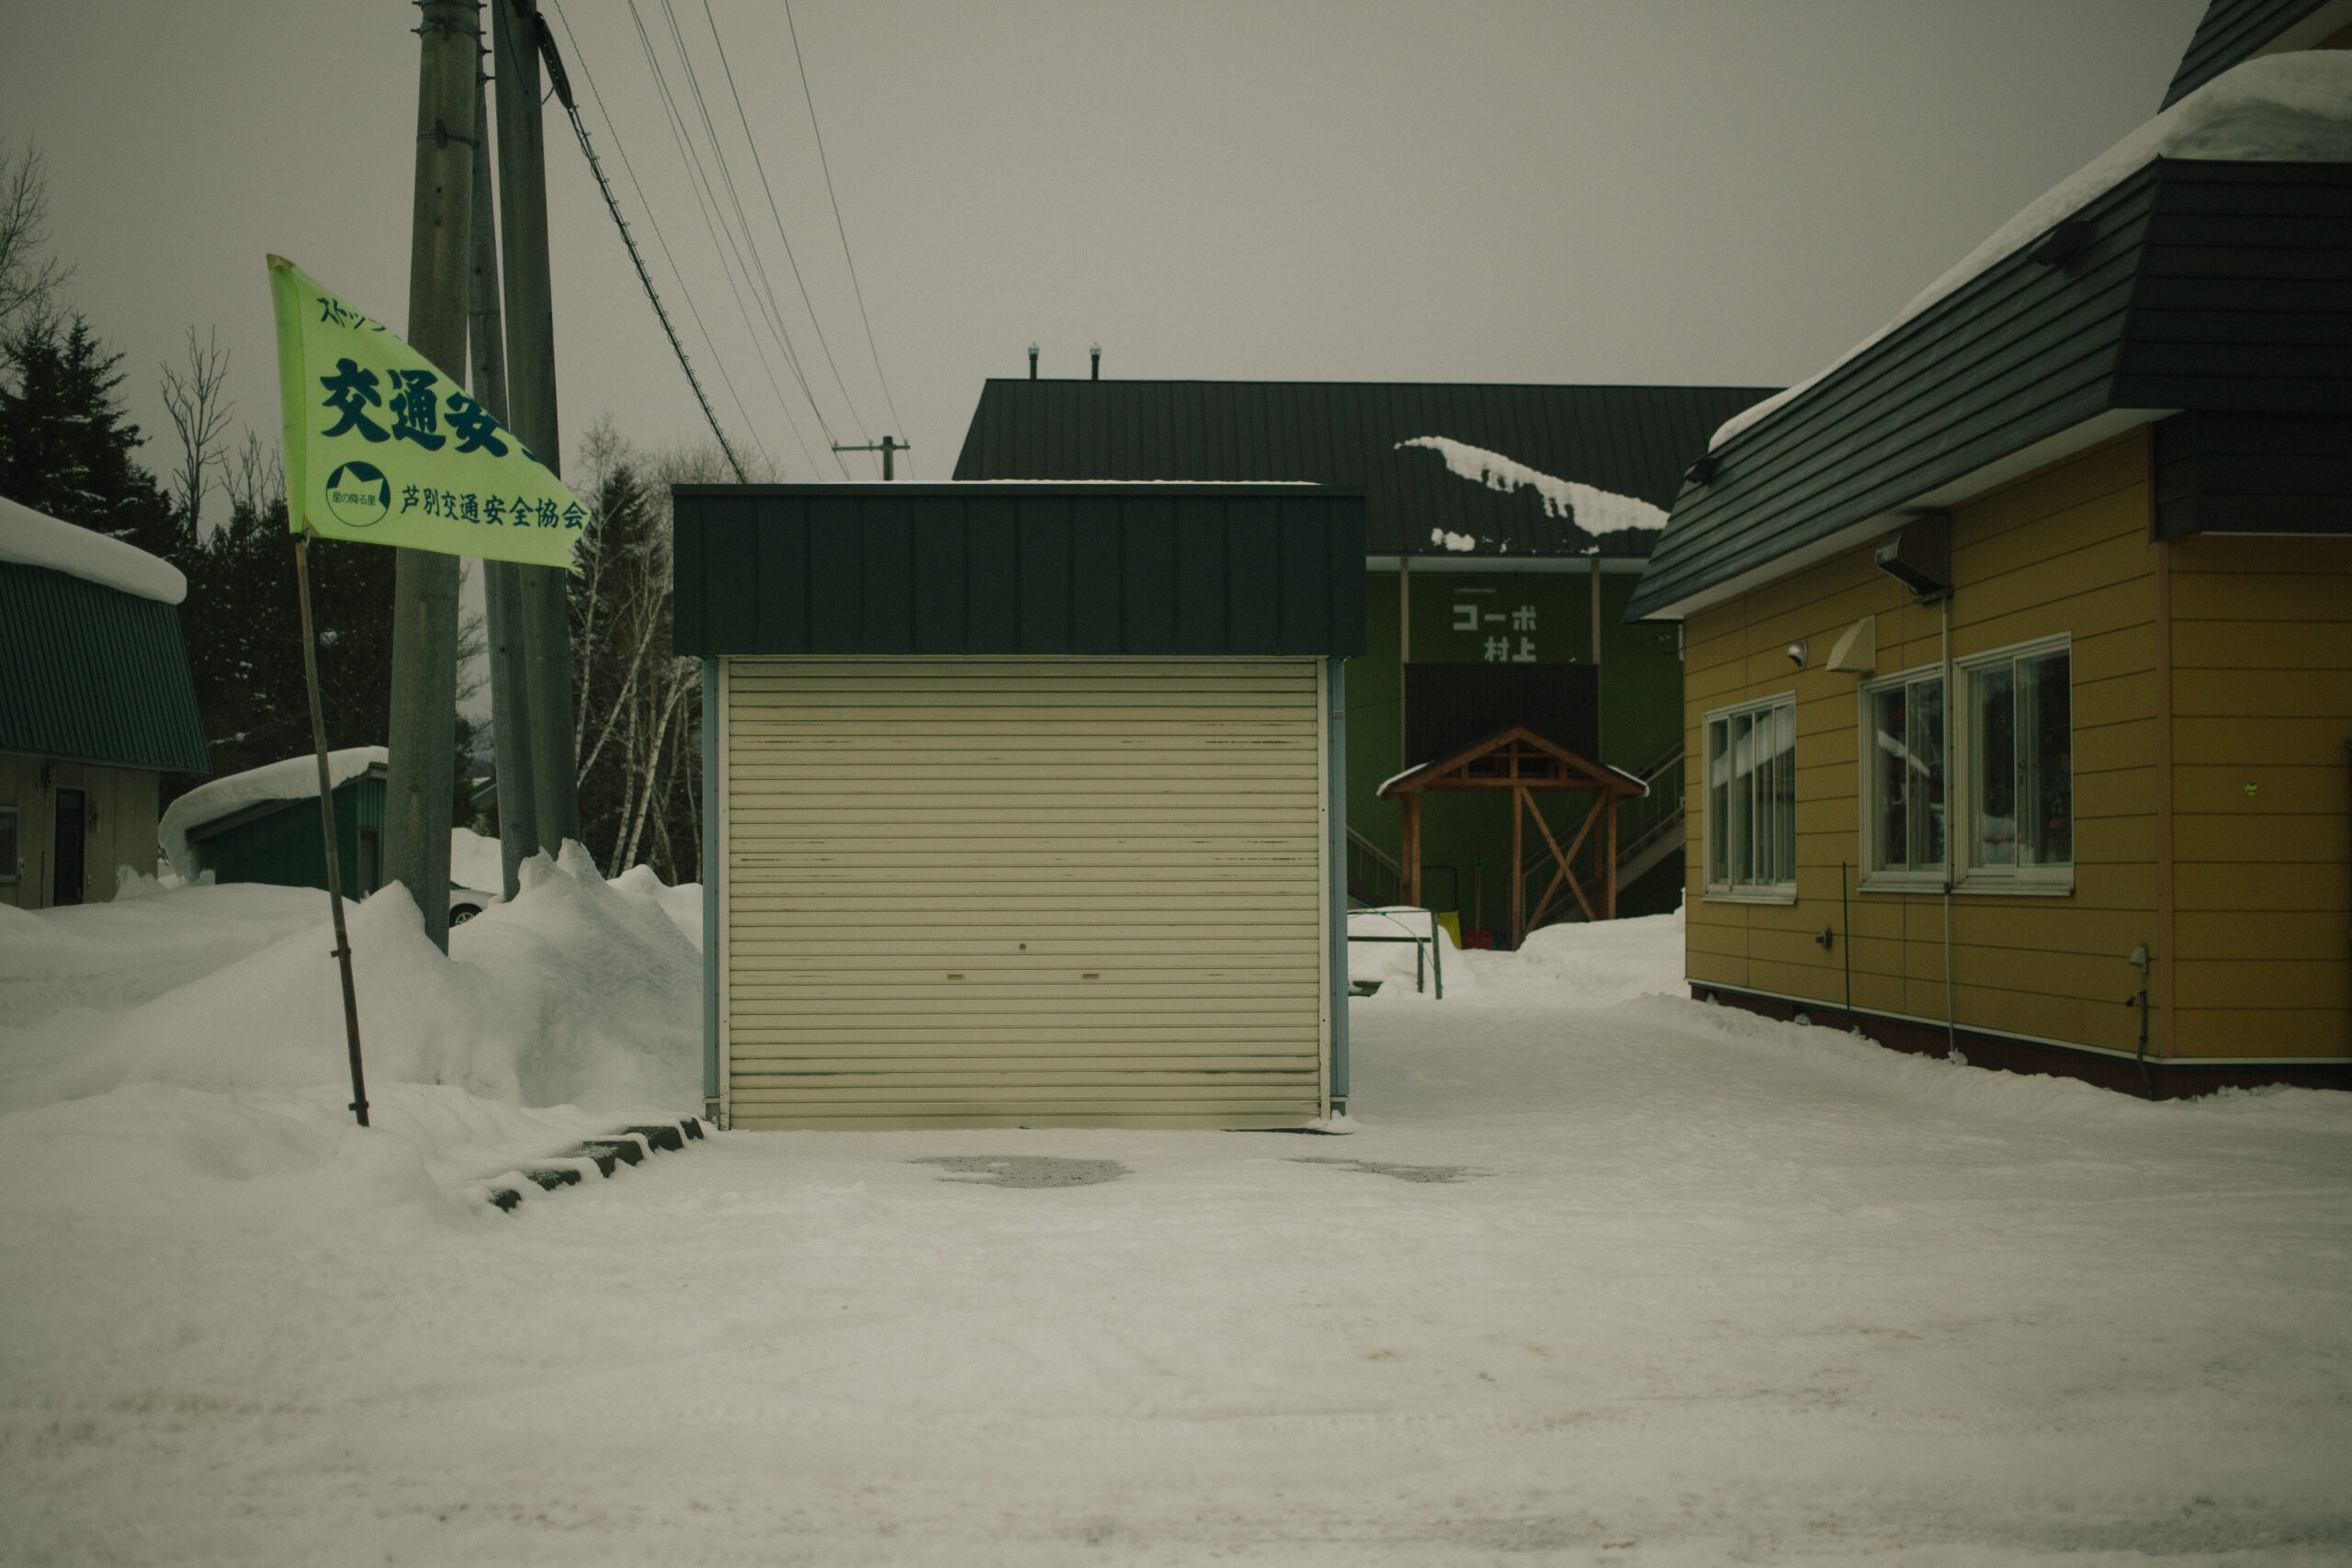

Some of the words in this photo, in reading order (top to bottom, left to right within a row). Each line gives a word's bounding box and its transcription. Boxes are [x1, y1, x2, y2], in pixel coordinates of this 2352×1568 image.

[319, 357, 538, 461] 交通安
[332, 491, 376, 506] 星の降る里
[401, 484, 588, 530] 芦別交通安全協会
[1453, 604, 1536, 631] コーポ
[1484, 636, 1537, 662] 村上
